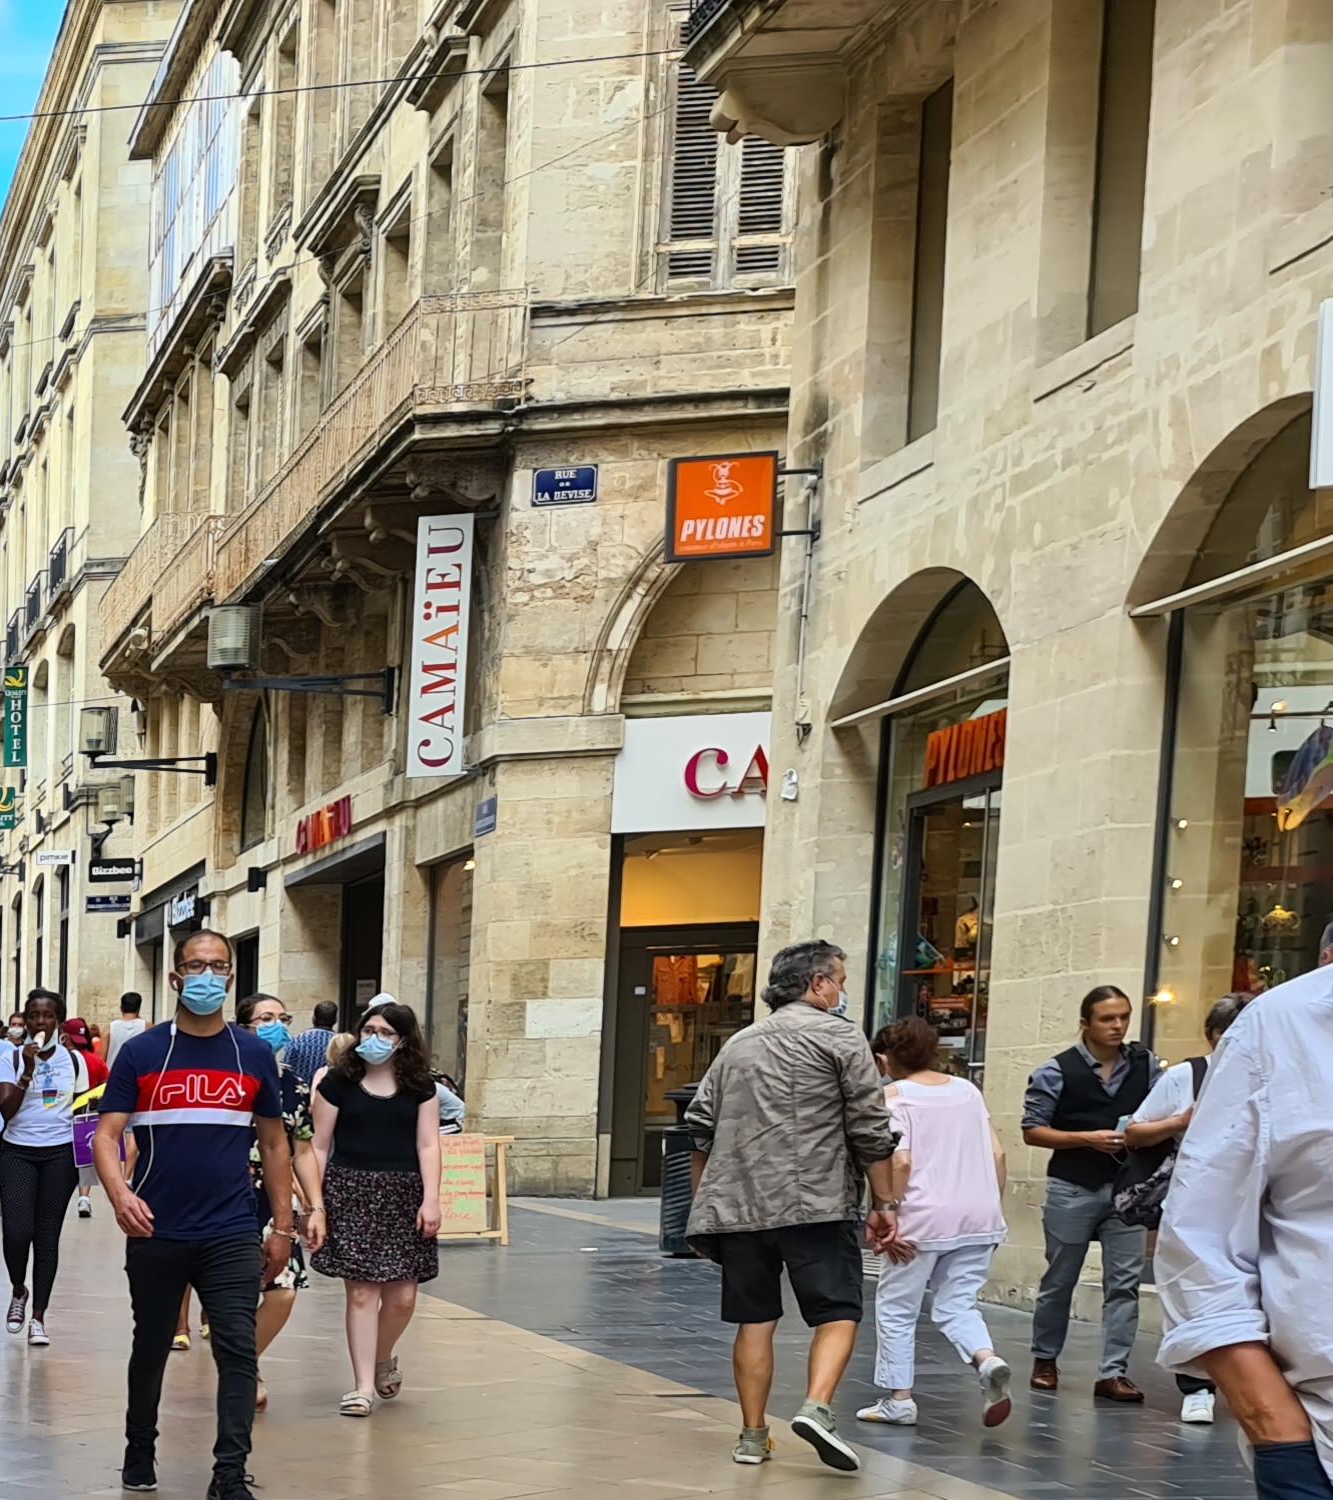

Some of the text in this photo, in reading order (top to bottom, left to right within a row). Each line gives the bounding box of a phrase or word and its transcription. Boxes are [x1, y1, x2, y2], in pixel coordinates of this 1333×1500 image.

[554, 470, 577, 479] RUE
[537, 489, 591, 501] LA DEVISE
[680, 514, 766, 542] PYLONES
[417, 524, 465, 768] CAMAïEU
[10, 699, 22, 763] HOTEL
[39, 853, 69, 862] pimkie
[159, 1074, 244, 1106] FILA
